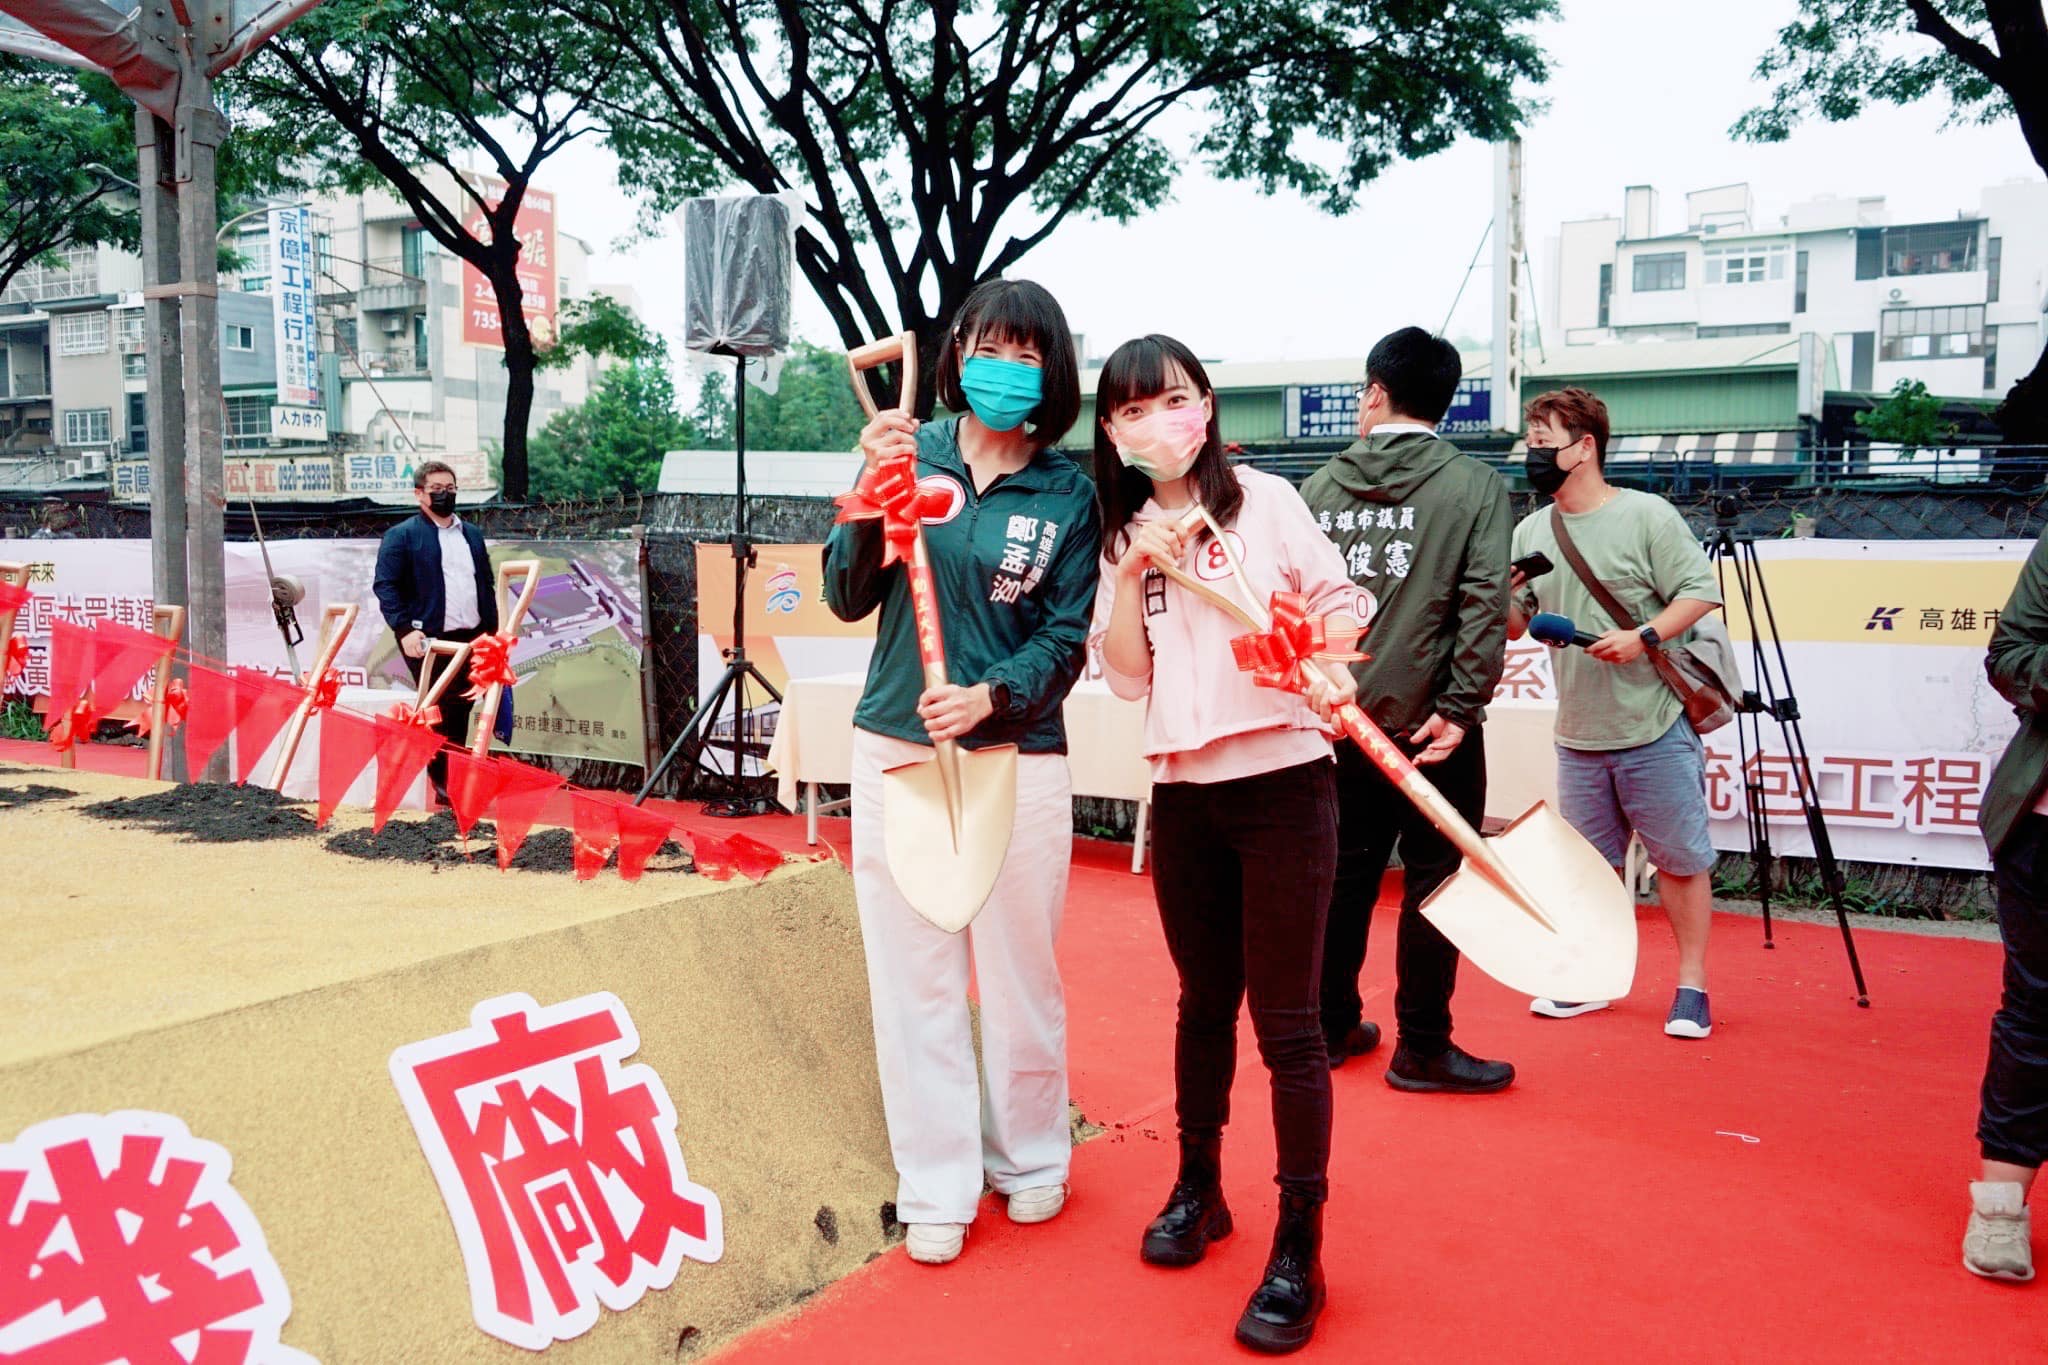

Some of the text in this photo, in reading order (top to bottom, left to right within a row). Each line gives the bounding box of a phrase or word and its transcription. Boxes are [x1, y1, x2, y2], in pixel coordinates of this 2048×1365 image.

[279, 211, 303, 340] 宗億工程行
[280, 409, 322, 428] 人力仲介
[1319, 507, 1415, 533] 高雄市議員
[1334, 540, 1414, 578] 俊憲
[474, 711, 605, 738] 政府捷運工程局
